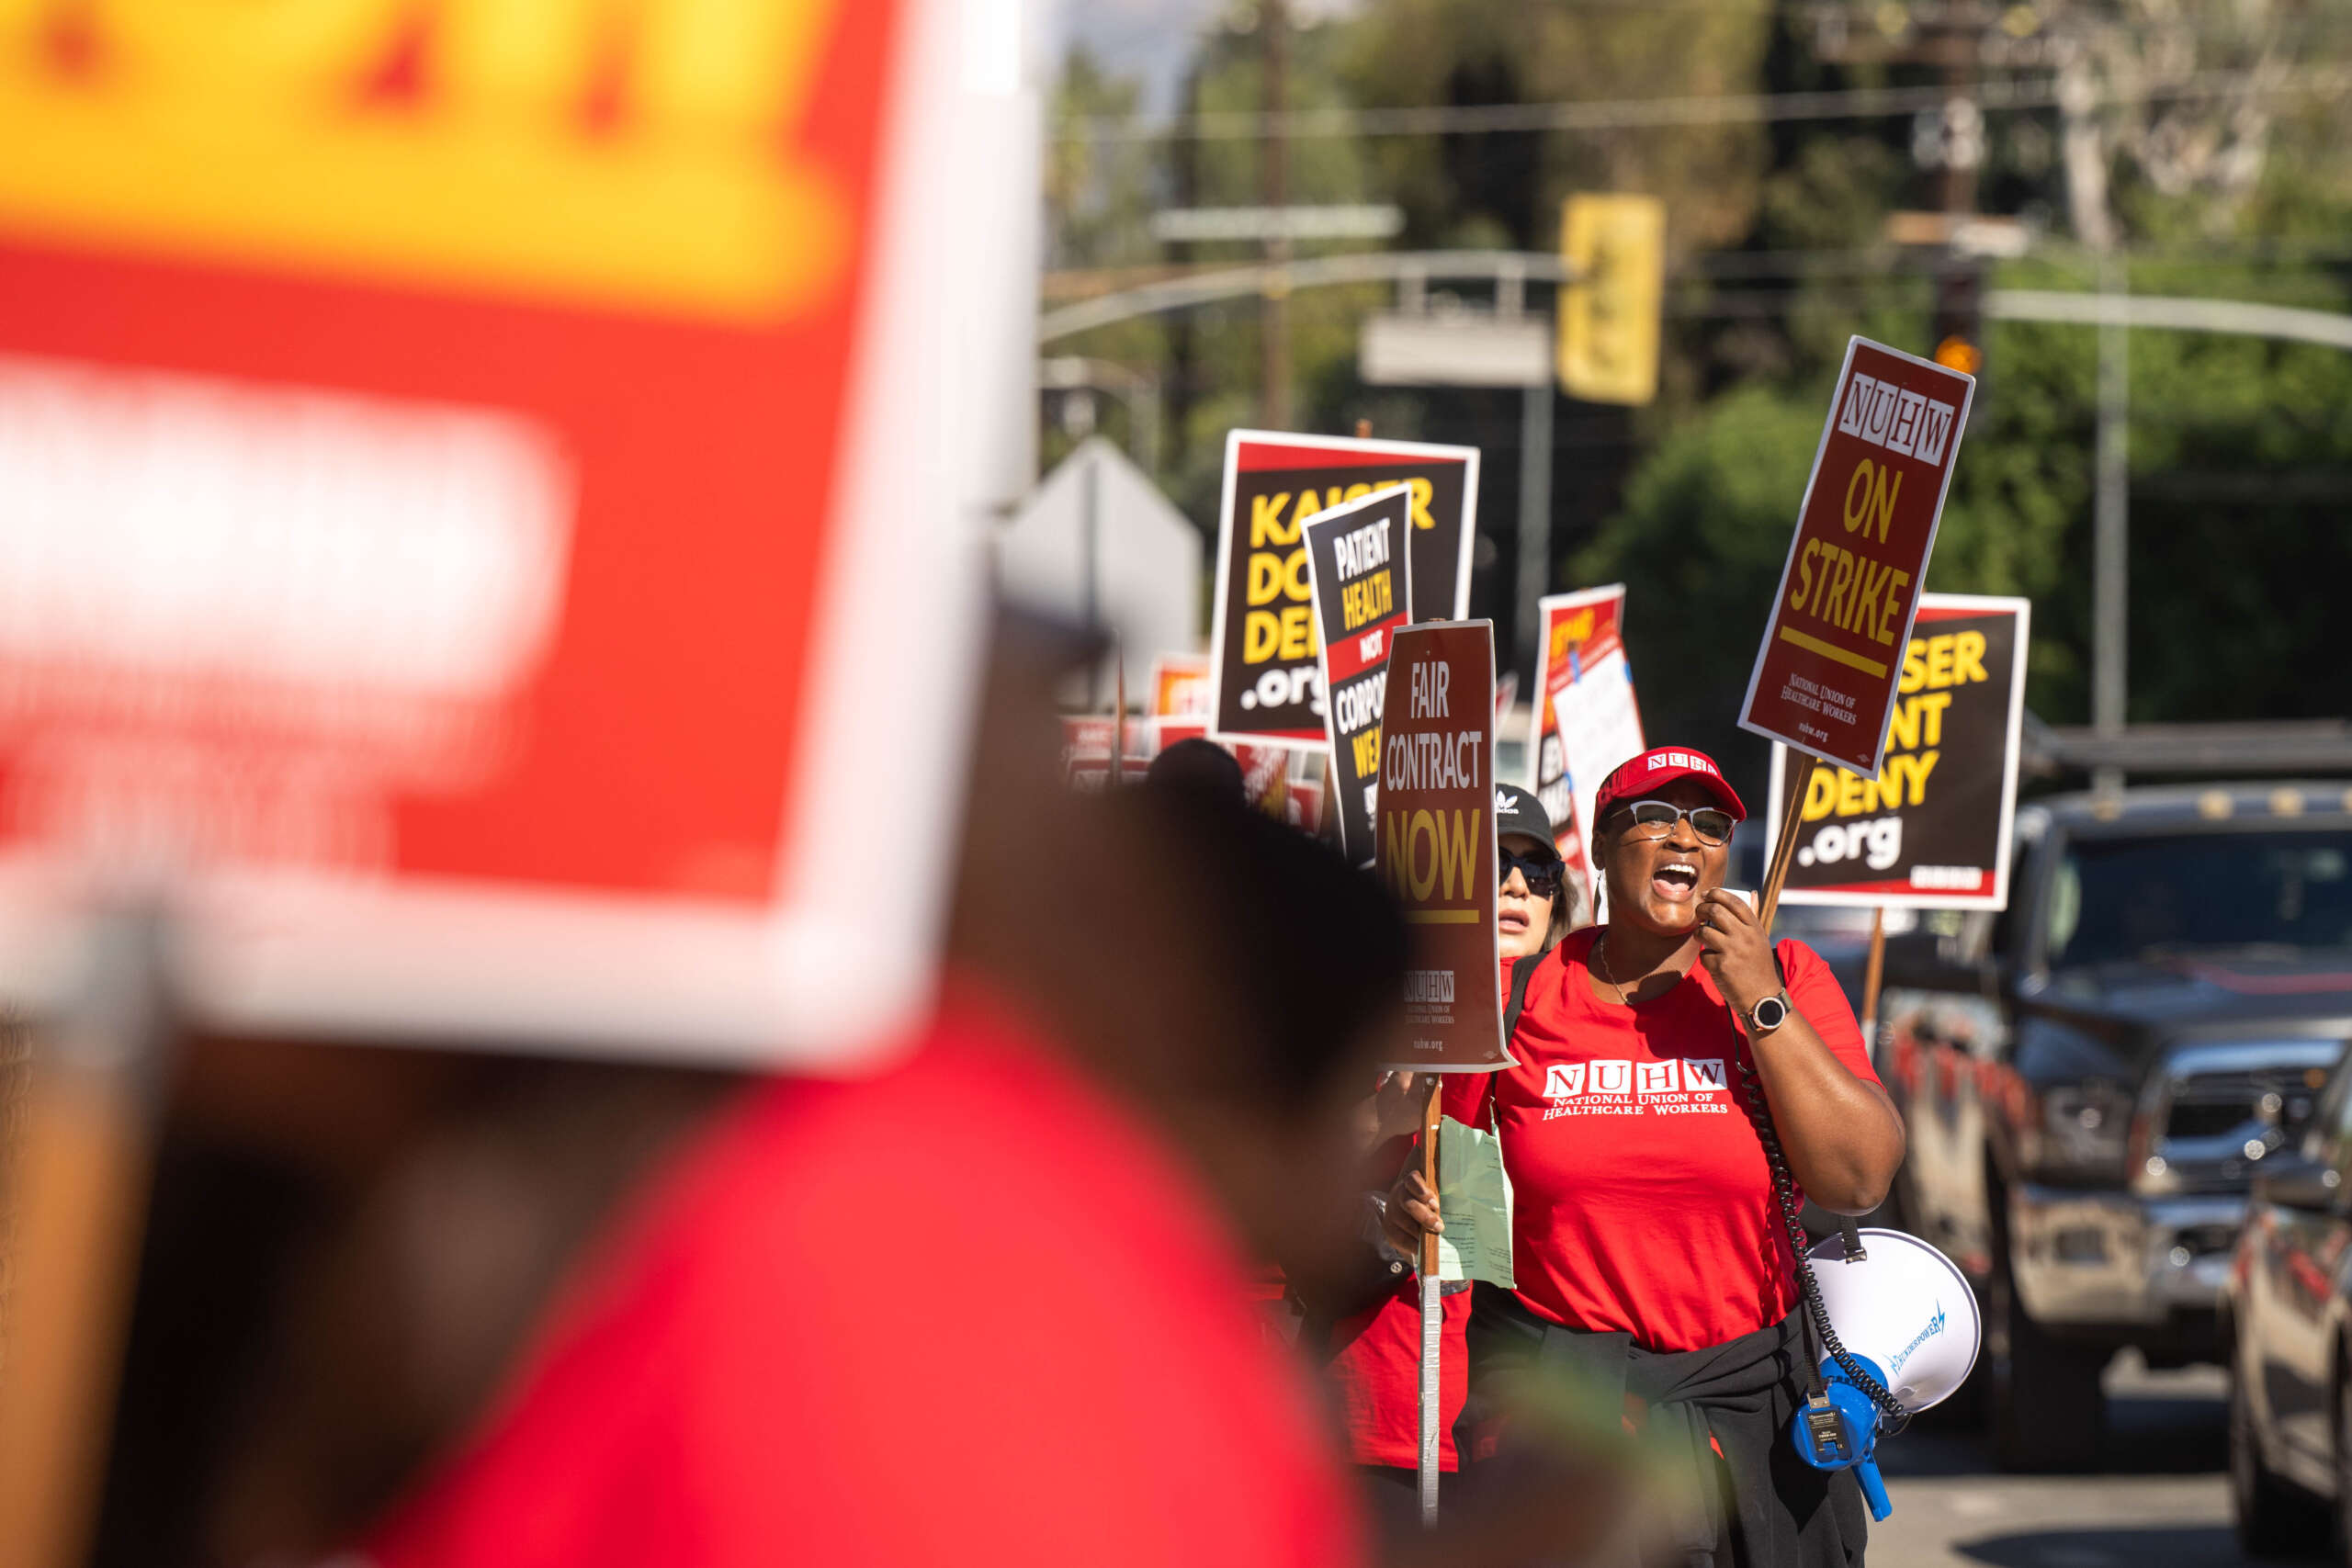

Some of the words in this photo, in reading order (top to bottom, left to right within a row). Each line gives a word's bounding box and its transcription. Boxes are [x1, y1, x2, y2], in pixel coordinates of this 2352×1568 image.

[1840, 377, 1953, 463] NUHW
[1844, 458, 1903, 544] ON
[1334, 517, 1390, 581] PATIENT
[1341, 569, 1393, 631] HEALTH
[1791, 537, 1910, 647] STRIKE
[1360, 629, 1384, 663] NOT
[1411, 661, 1450, 718] FAIR
[1820, 685, 1846, 705] UNION
[1845, 697, 1856, 708] OF
[1822, 702, 1857, 726] WORKERS
[1386, 731, 1482, 791] CONTRACT
[1803, 750, 1939, 822] DENY
[1386, 808, 1480, 901] NOW
[1798, 816, 1903, 870] .org
[1404, 971, 1454, 1002] NUHW
[1545, 1059, 1726, 1097] NUHW
[1554, 1094, 1633, 1108] NATIONAL
[1638, 1093, 1689, 1105] UNION
[1694, 1093, 1713, 1103] OF
[1543, 1105, 1644, 1121] HEALTHCARE
[1654, 1103, 1728, 1116] WORKERS
